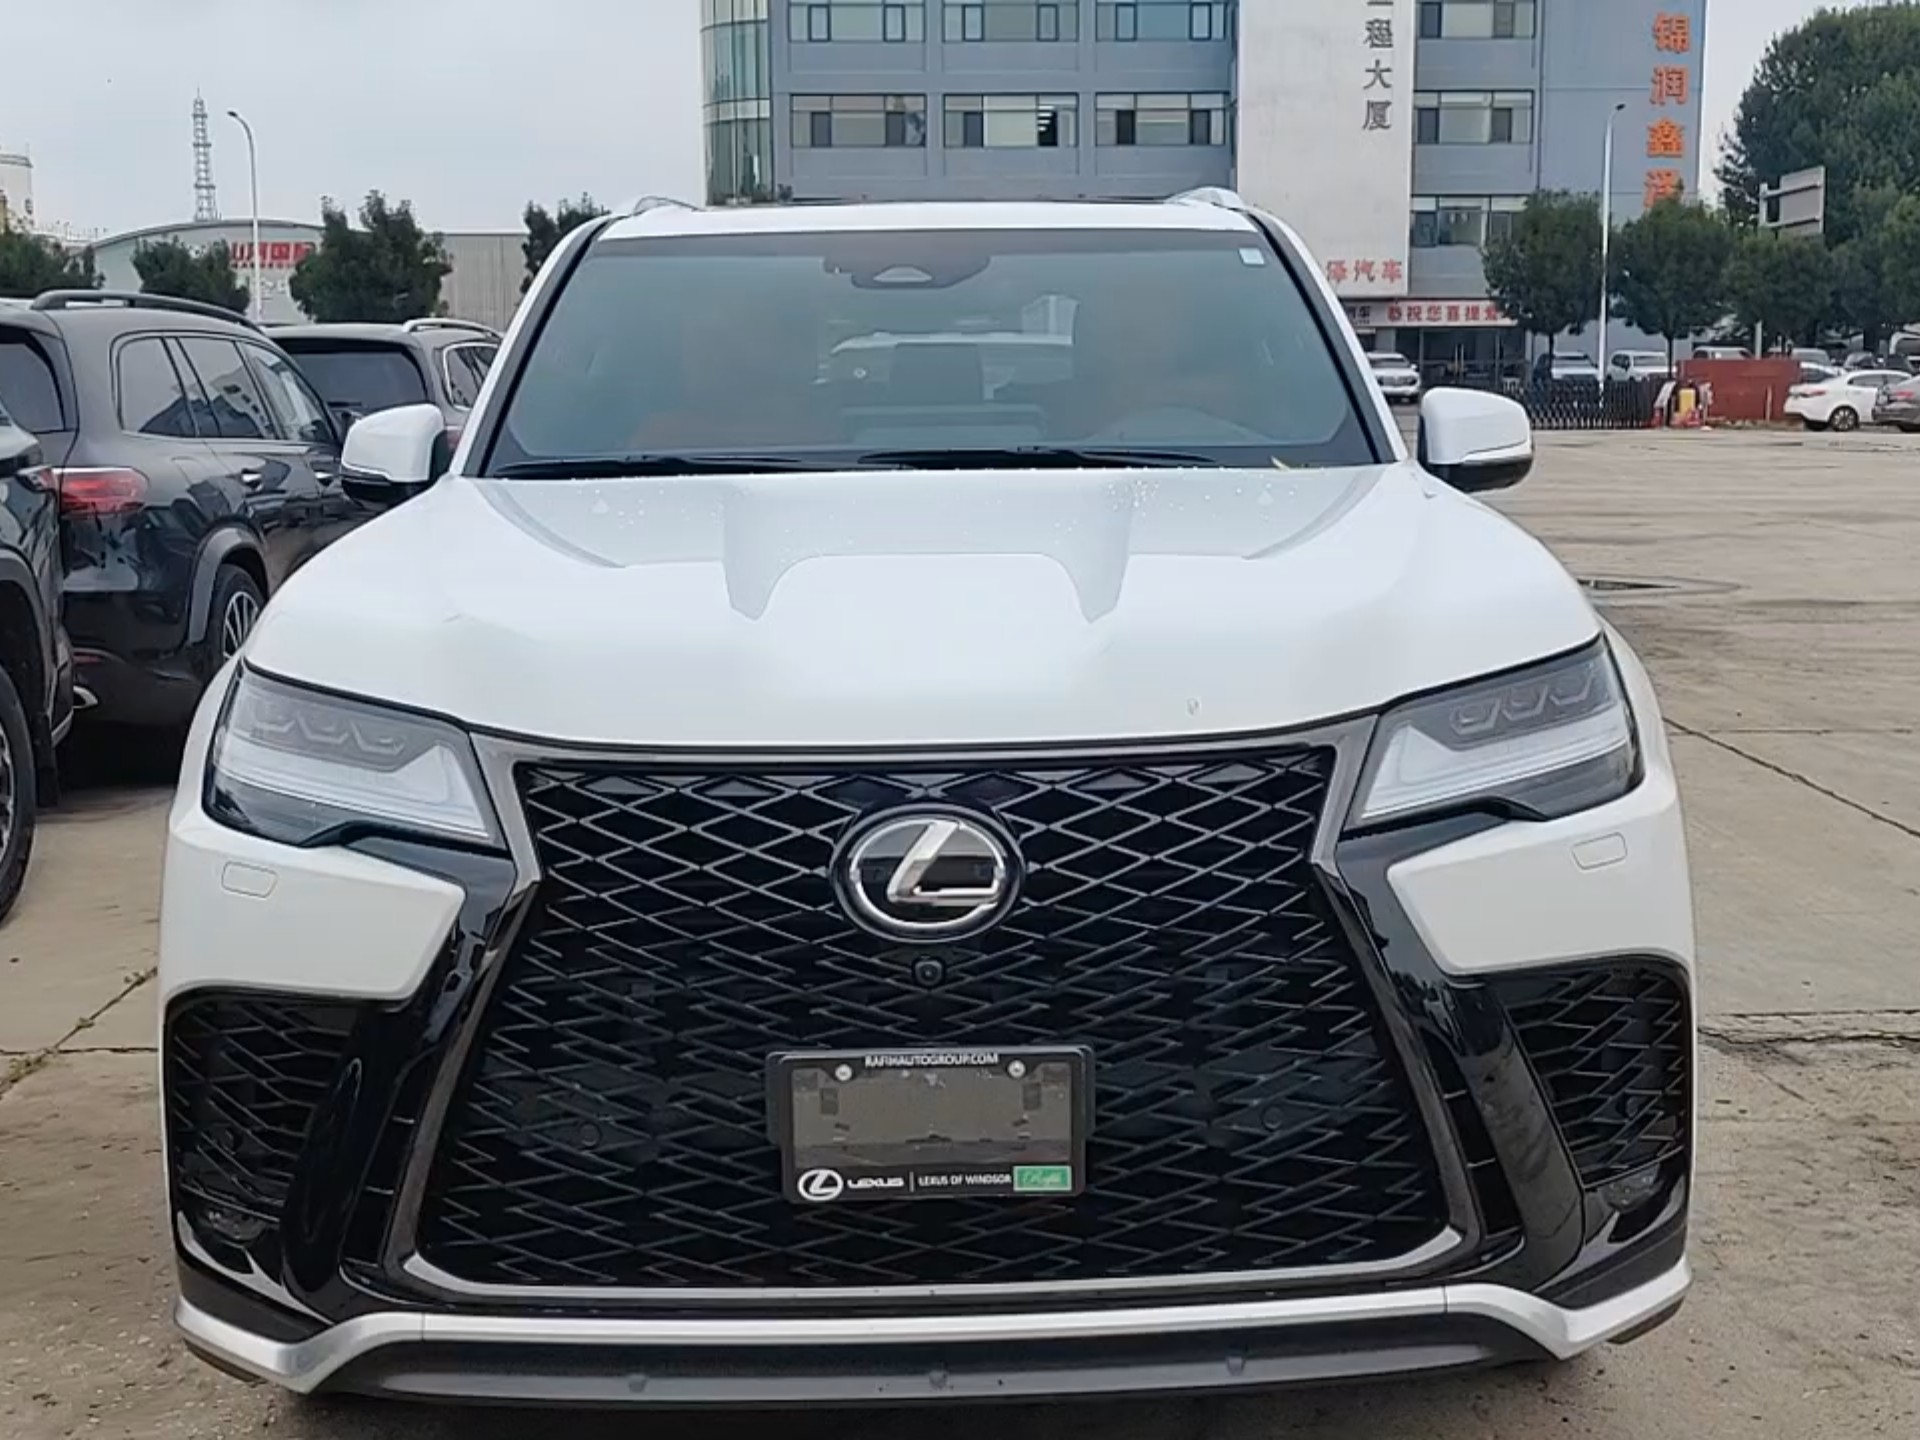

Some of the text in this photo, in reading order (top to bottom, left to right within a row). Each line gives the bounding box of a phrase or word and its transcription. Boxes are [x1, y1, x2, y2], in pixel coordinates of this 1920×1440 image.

[1363, 0, 1394, 131] 程大厦
[847, 1177, 904, 1189] LEXUS
[918, 1175, 949, 1187] LEXUS
[951, 1174, 964, 1186] OF
[965, 1173, 1012, 1186] WINDSOR
